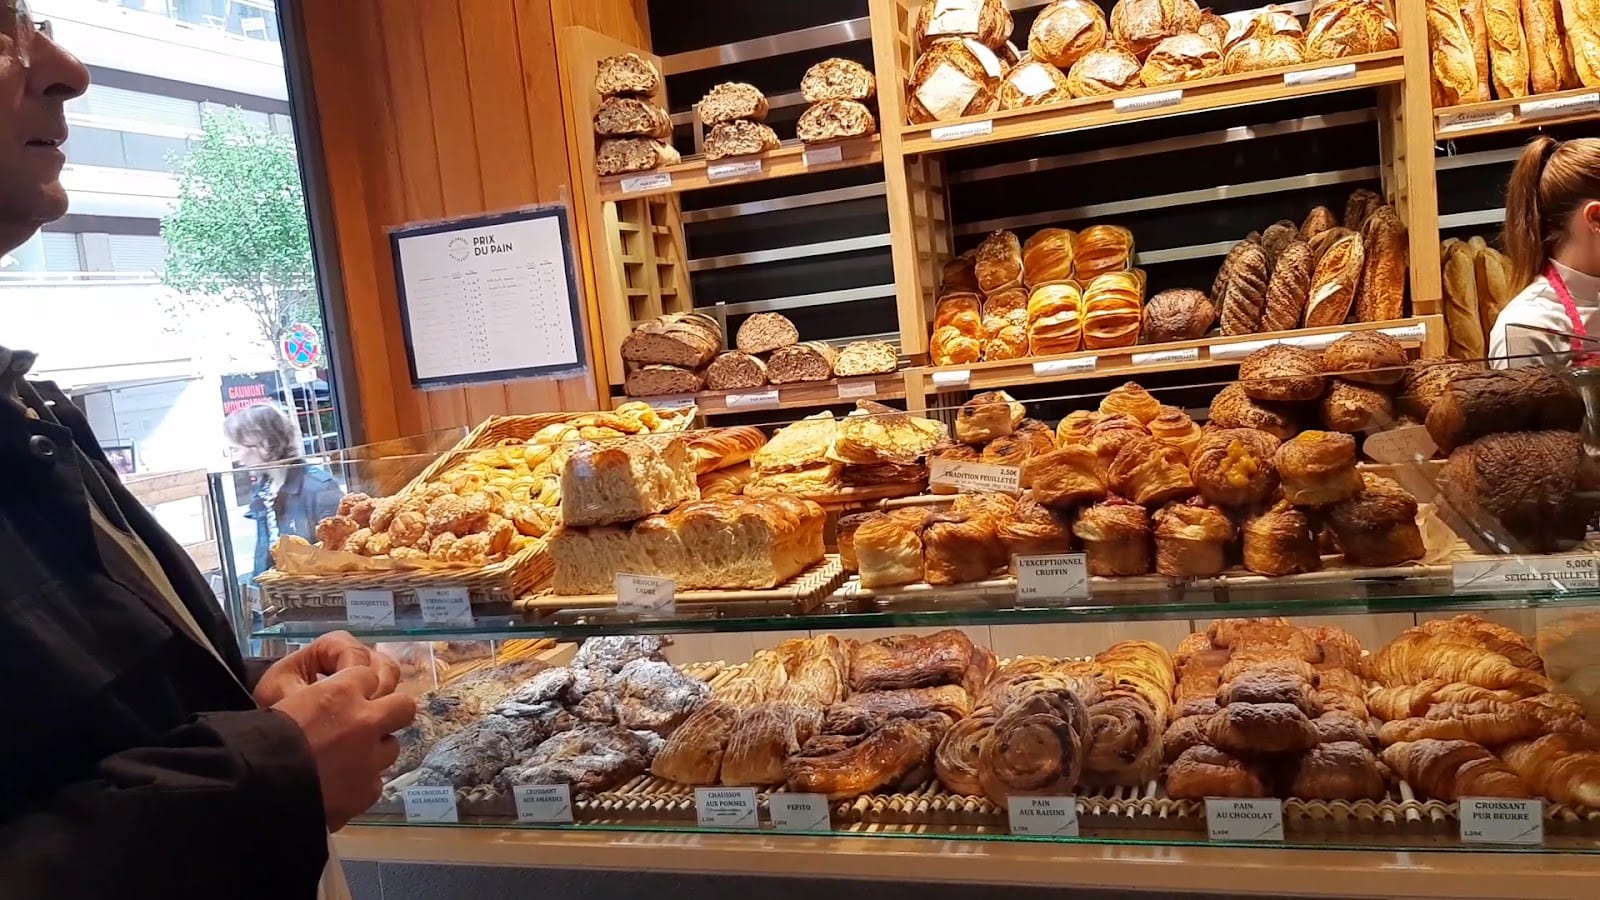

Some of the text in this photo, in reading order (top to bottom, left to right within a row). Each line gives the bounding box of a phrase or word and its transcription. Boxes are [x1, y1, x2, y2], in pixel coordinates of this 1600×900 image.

[473, 234, 495, 246] PRIX
[474, 246, 489, 256] DU
[490, 242, 513, 254] PAIN
[228, 383, 266, 400] GAUMONT
[945, 471, 979, 481] TRADITION
[1020, 558, 1083, 567] L'EXCEPTIONNEL
[1566, 560, 1593, 569] 5,00€
[1035, 568, 1068, 576] CRUFFIN
[1504, 573, 1539, 582] SEIGLE
[1475, 802, 1527, 810] CROISSANT
[1473, 812, 1529, 820] PUR BEURRE
